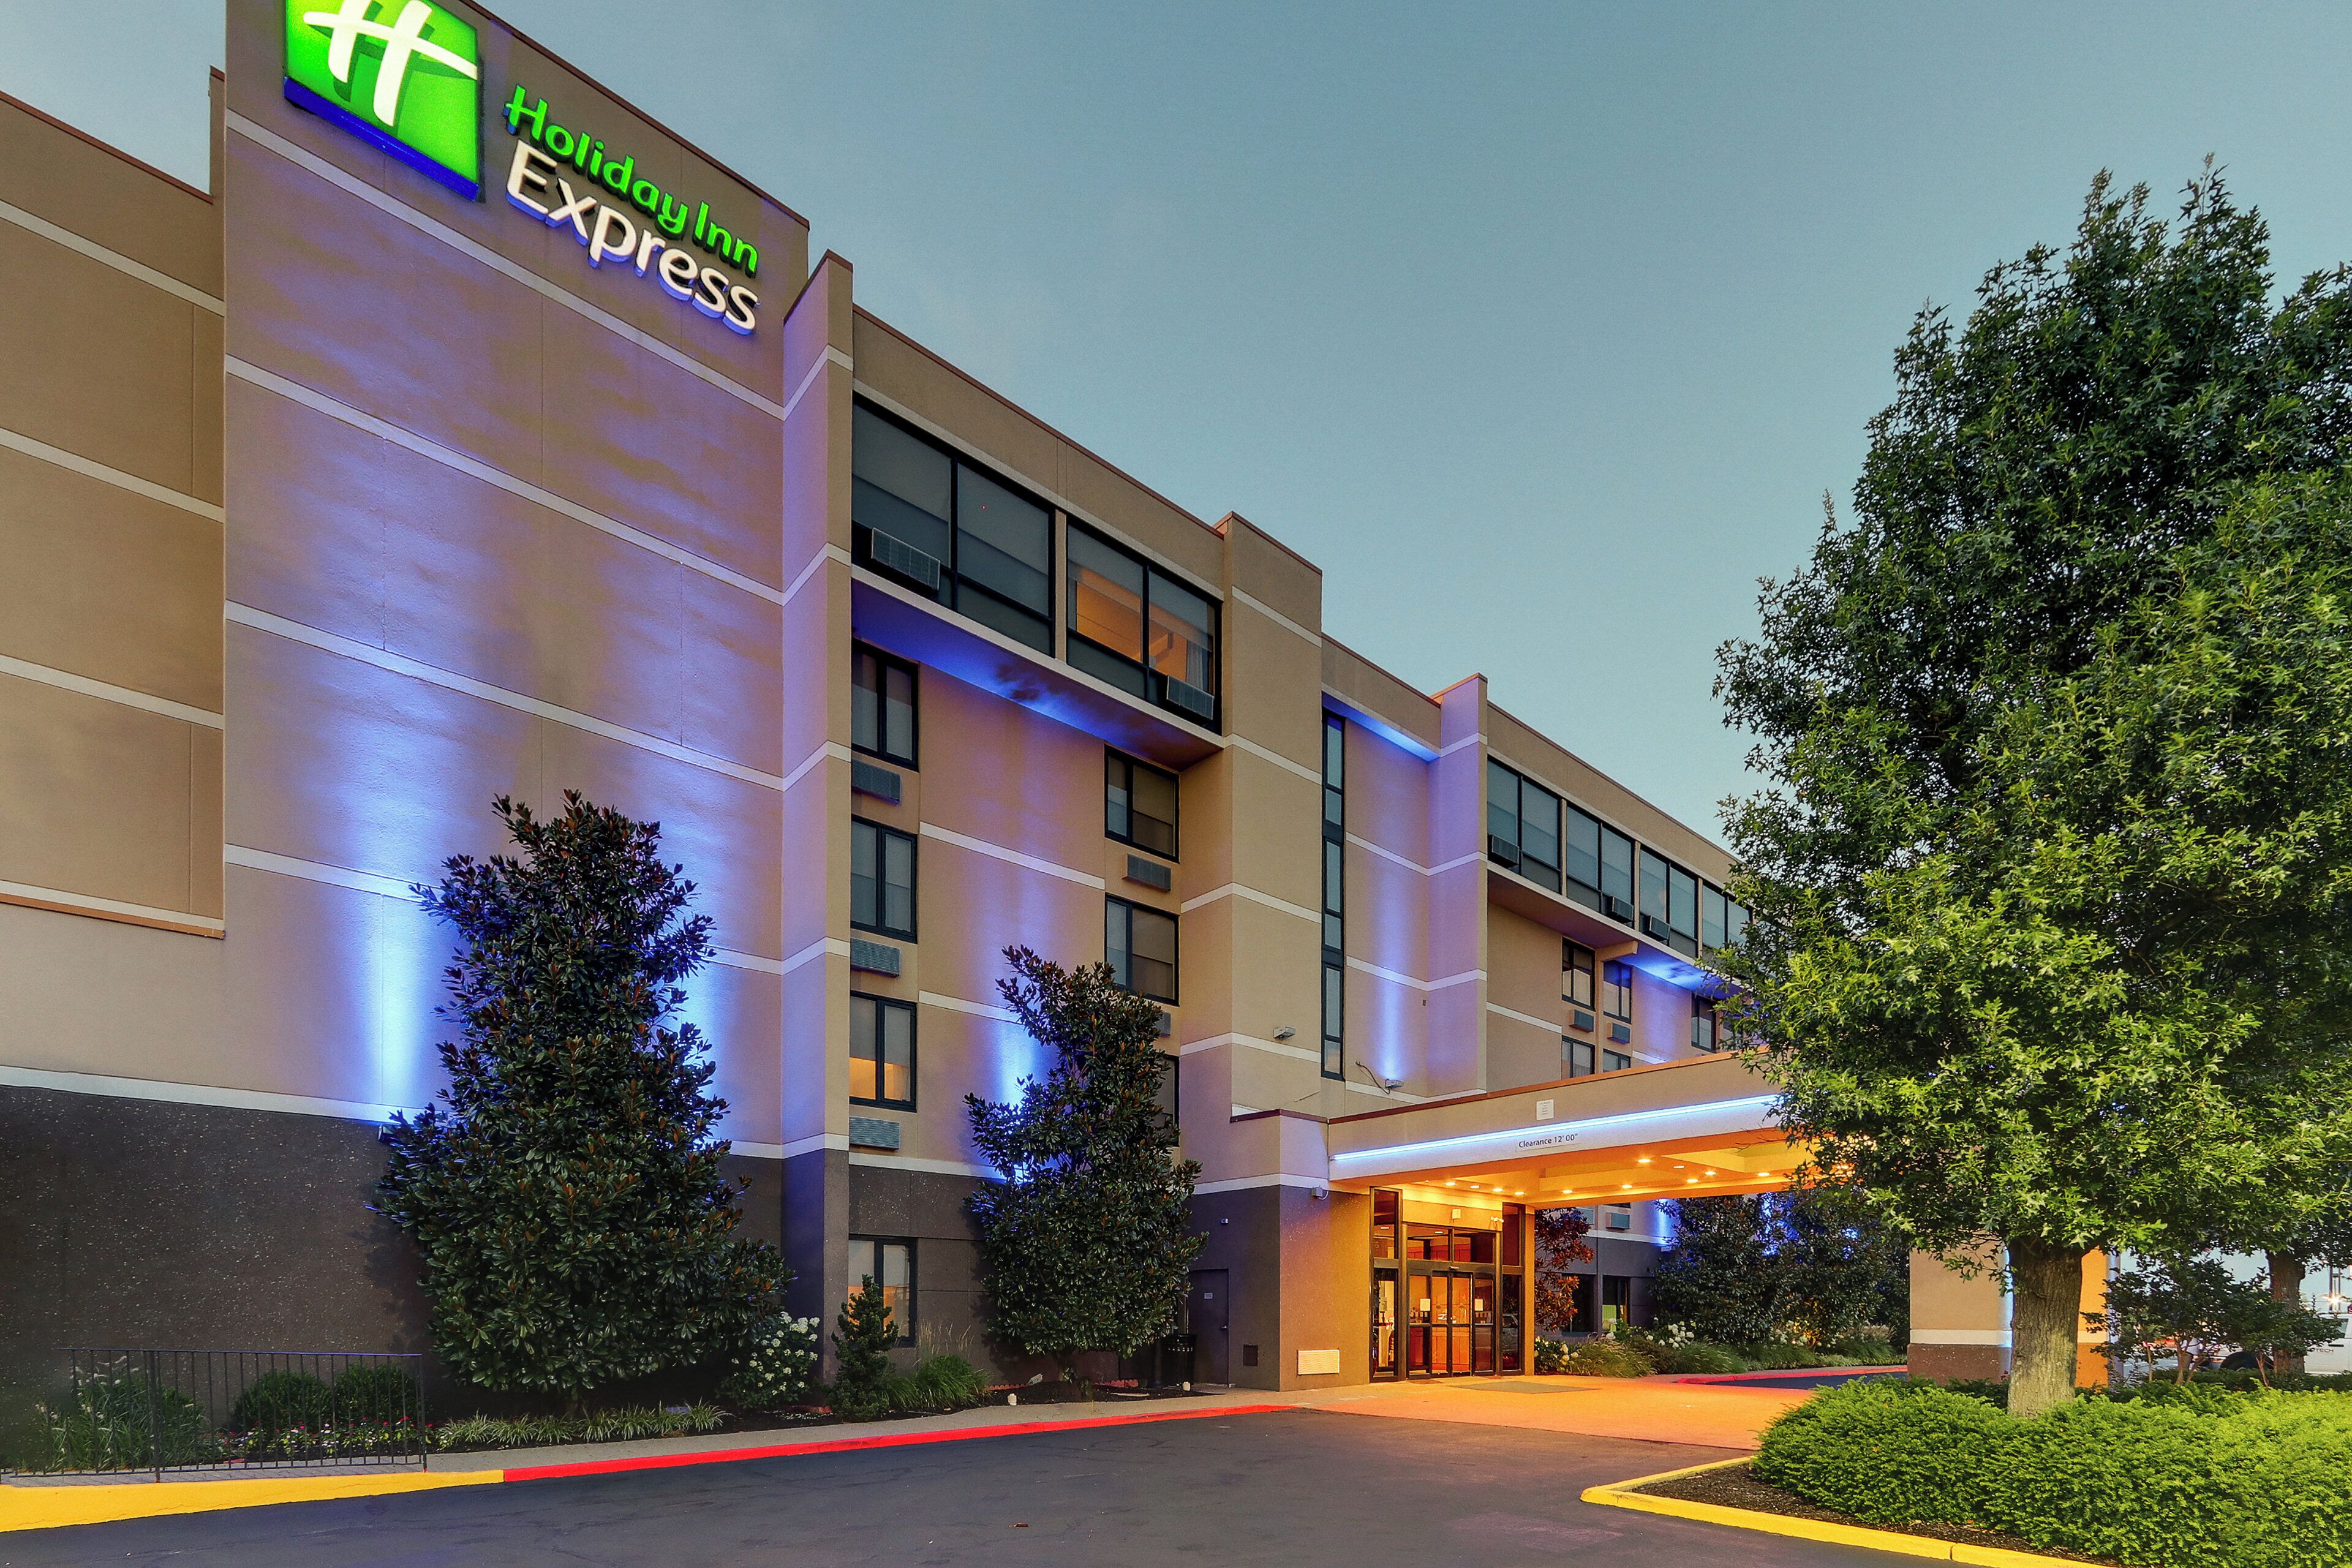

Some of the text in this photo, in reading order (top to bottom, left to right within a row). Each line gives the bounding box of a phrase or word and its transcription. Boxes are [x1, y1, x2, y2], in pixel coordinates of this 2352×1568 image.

[504, 85, 758, 275] Holiday Inn
[506, 139, 760, 333] Express
[1519, 1139, 1552, 1148] Clearance
